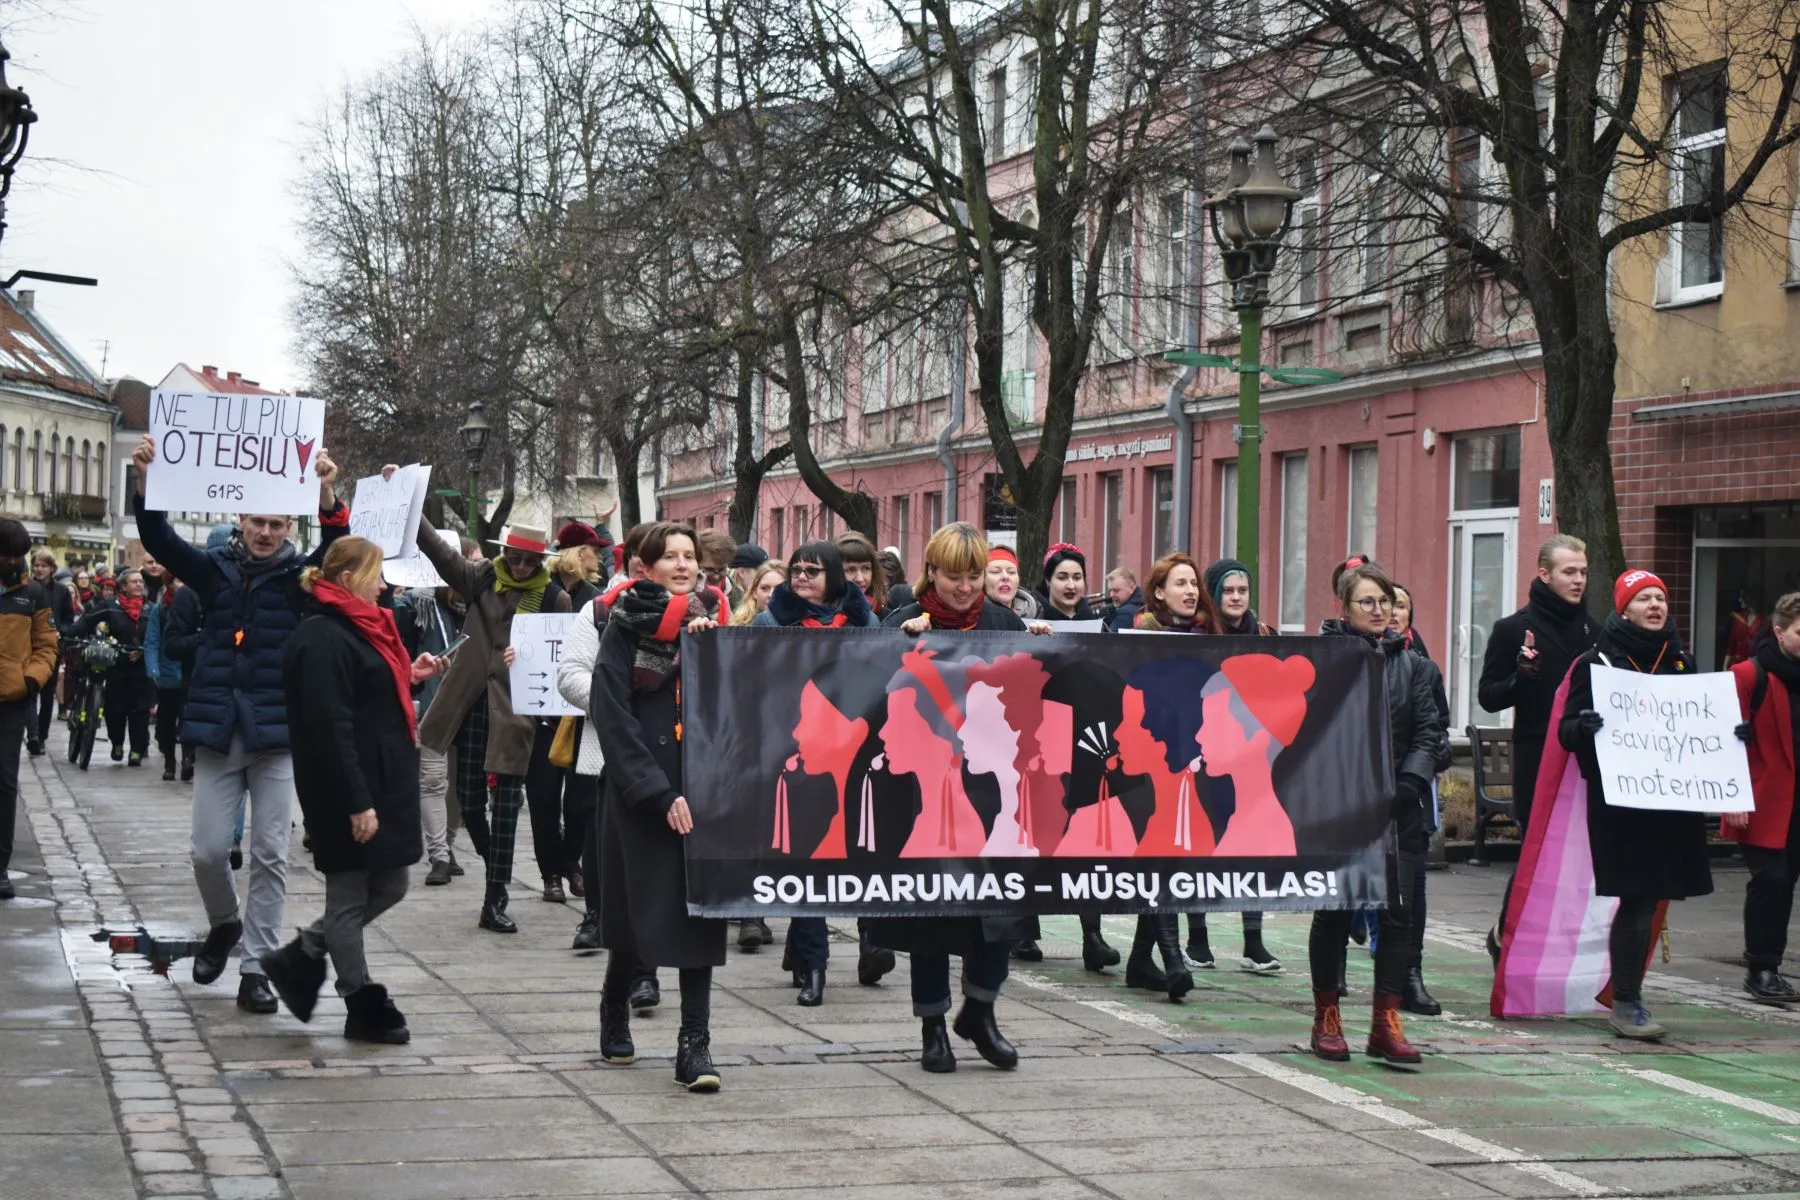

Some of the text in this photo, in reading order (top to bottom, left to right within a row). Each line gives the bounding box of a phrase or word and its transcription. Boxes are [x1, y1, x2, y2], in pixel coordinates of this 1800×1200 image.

[154, 393, 193, 428] NE
[162, 429, 186, 465] O
[207, 484, 244, 501] G1PS
[1540, 485, 1551, 518] 39
[1611, 729, 1723, 764] savigyna
[1617, 768, 1739, 800] moterims
[753, 873, 1026, 904] SOLIDARUMAS
[1061, 865, 1160, 907] MŪSŲ
[1168, 871, 1338, 899] GINKLAS!
